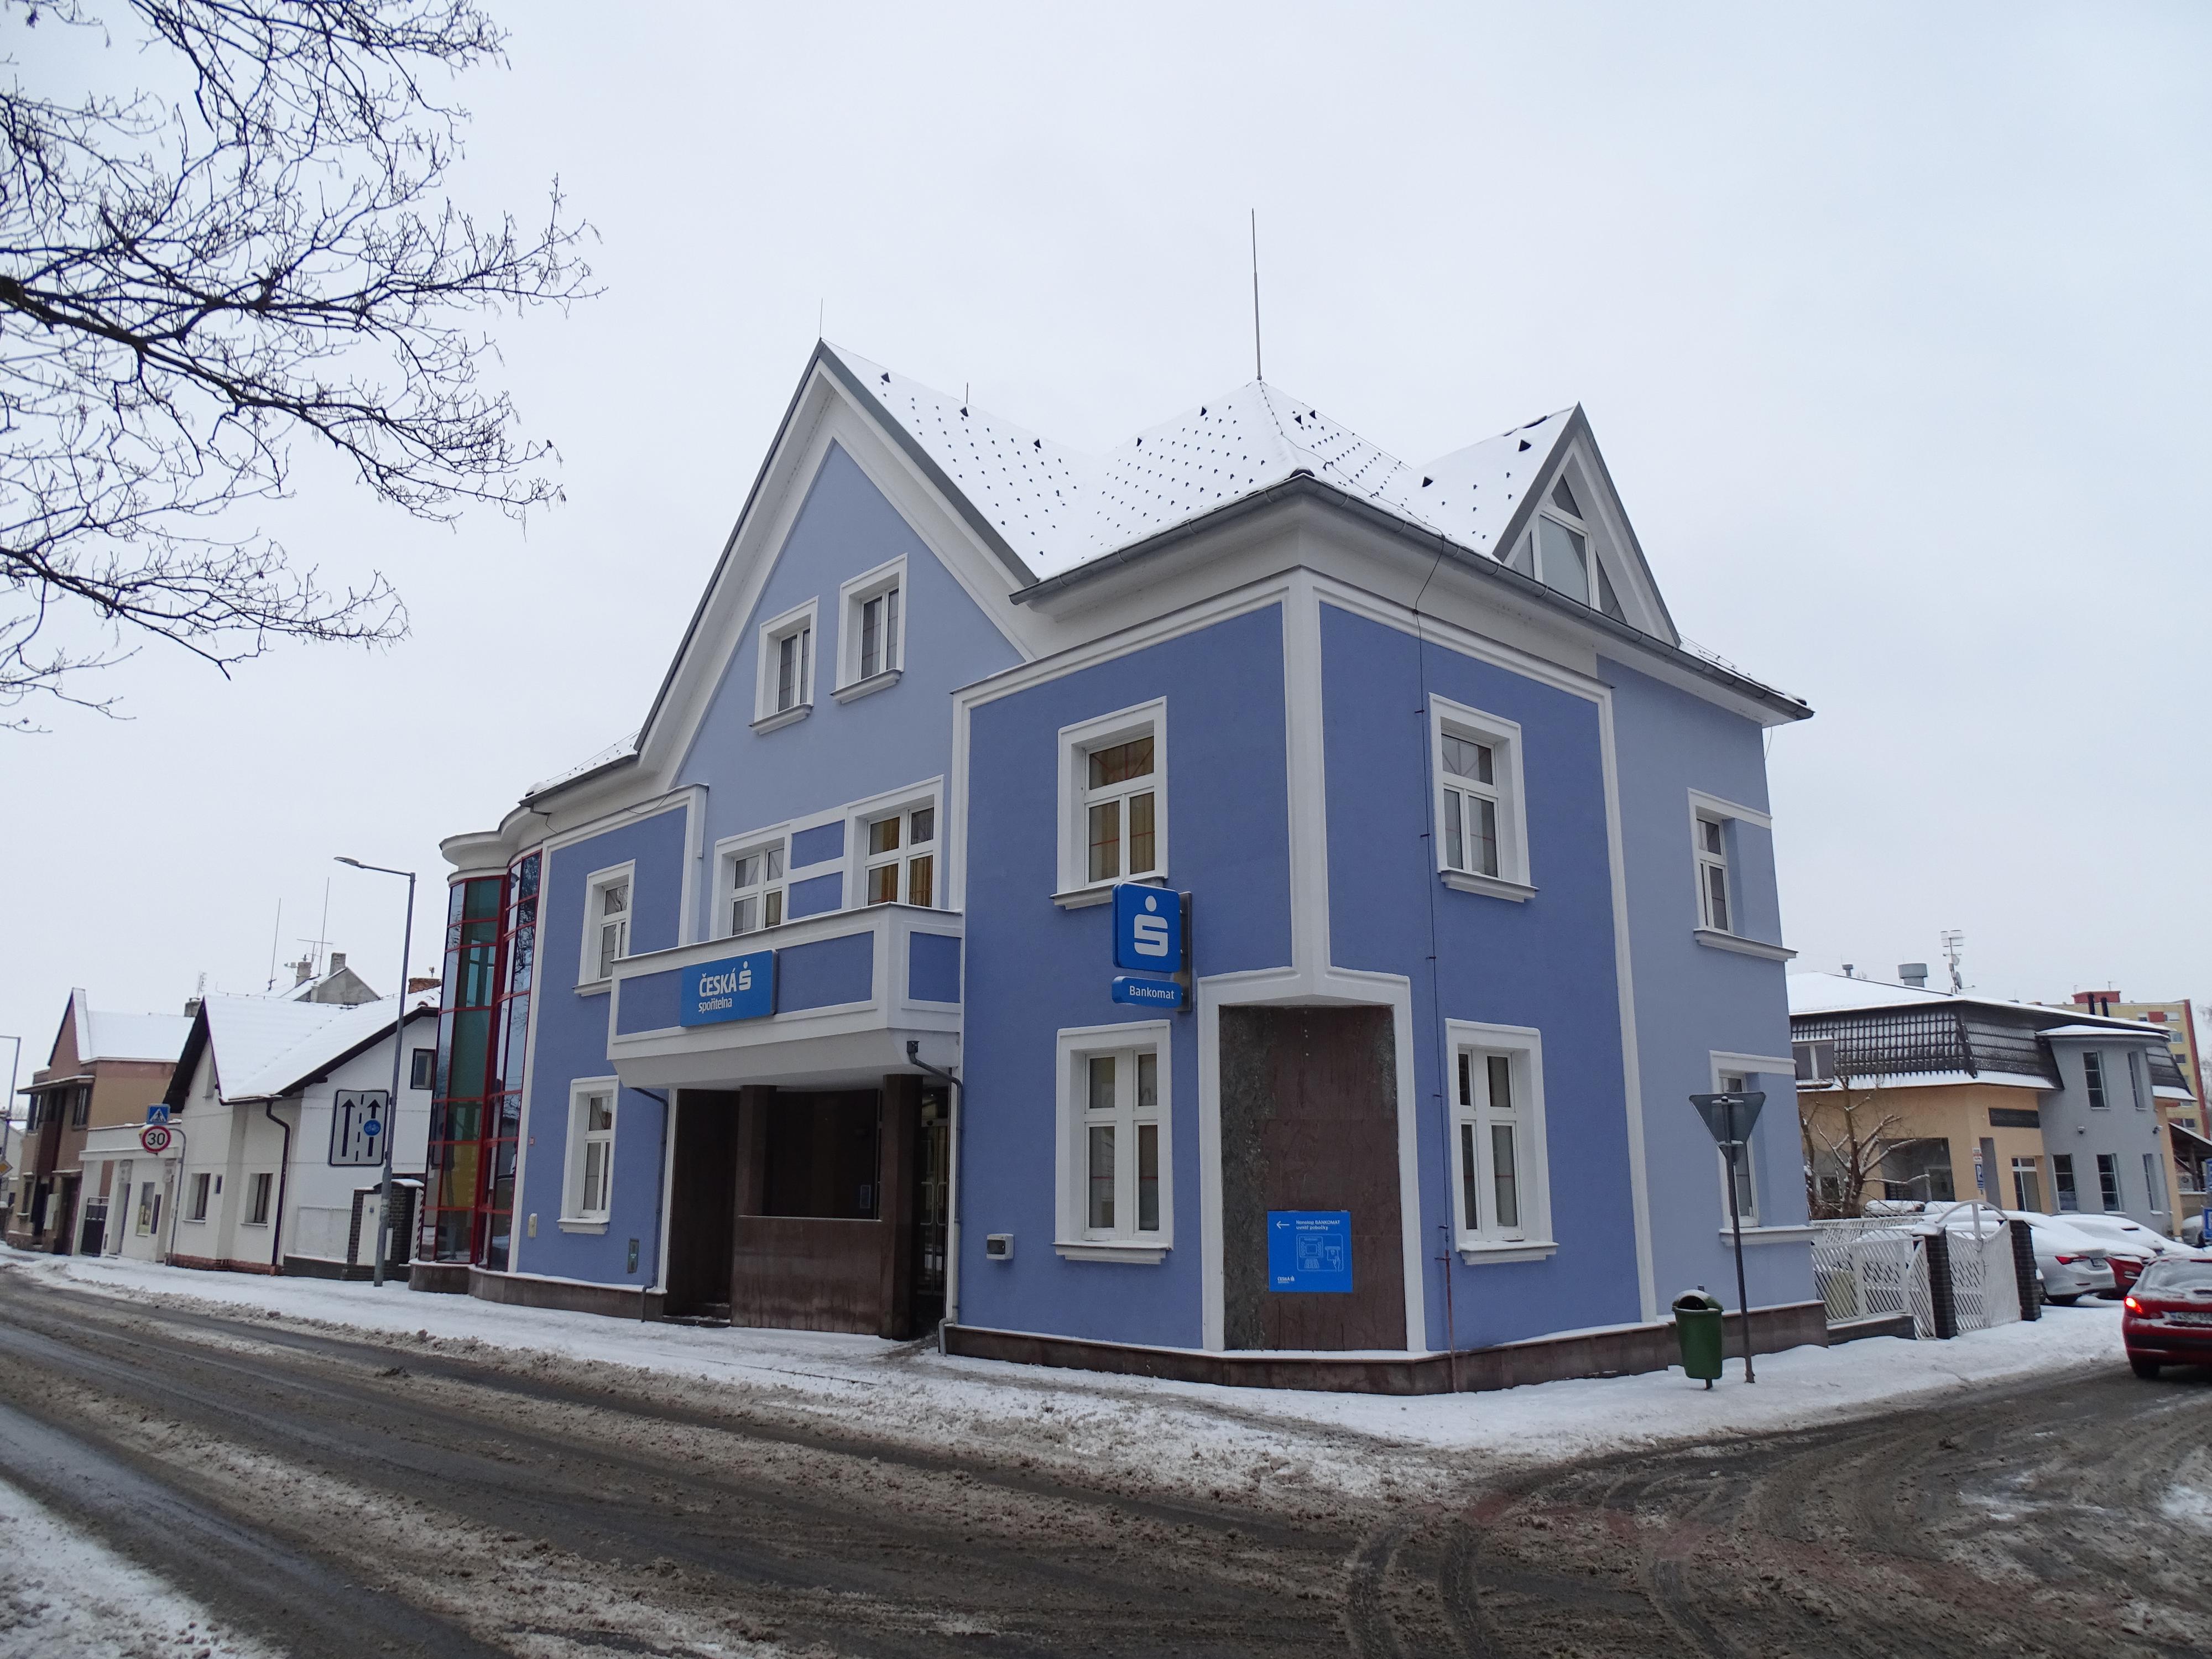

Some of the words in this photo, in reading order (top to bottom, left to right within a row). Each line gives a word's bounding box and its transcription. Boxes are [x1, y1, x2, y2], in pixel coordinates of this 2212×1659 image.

[699, 968, 737, 997] ČESKÁ
[1129, 985, 1175, 999] Bankomat
[698, 997, 732, 1014] spořitelna
[147, 1133, 165, 1145] 30
